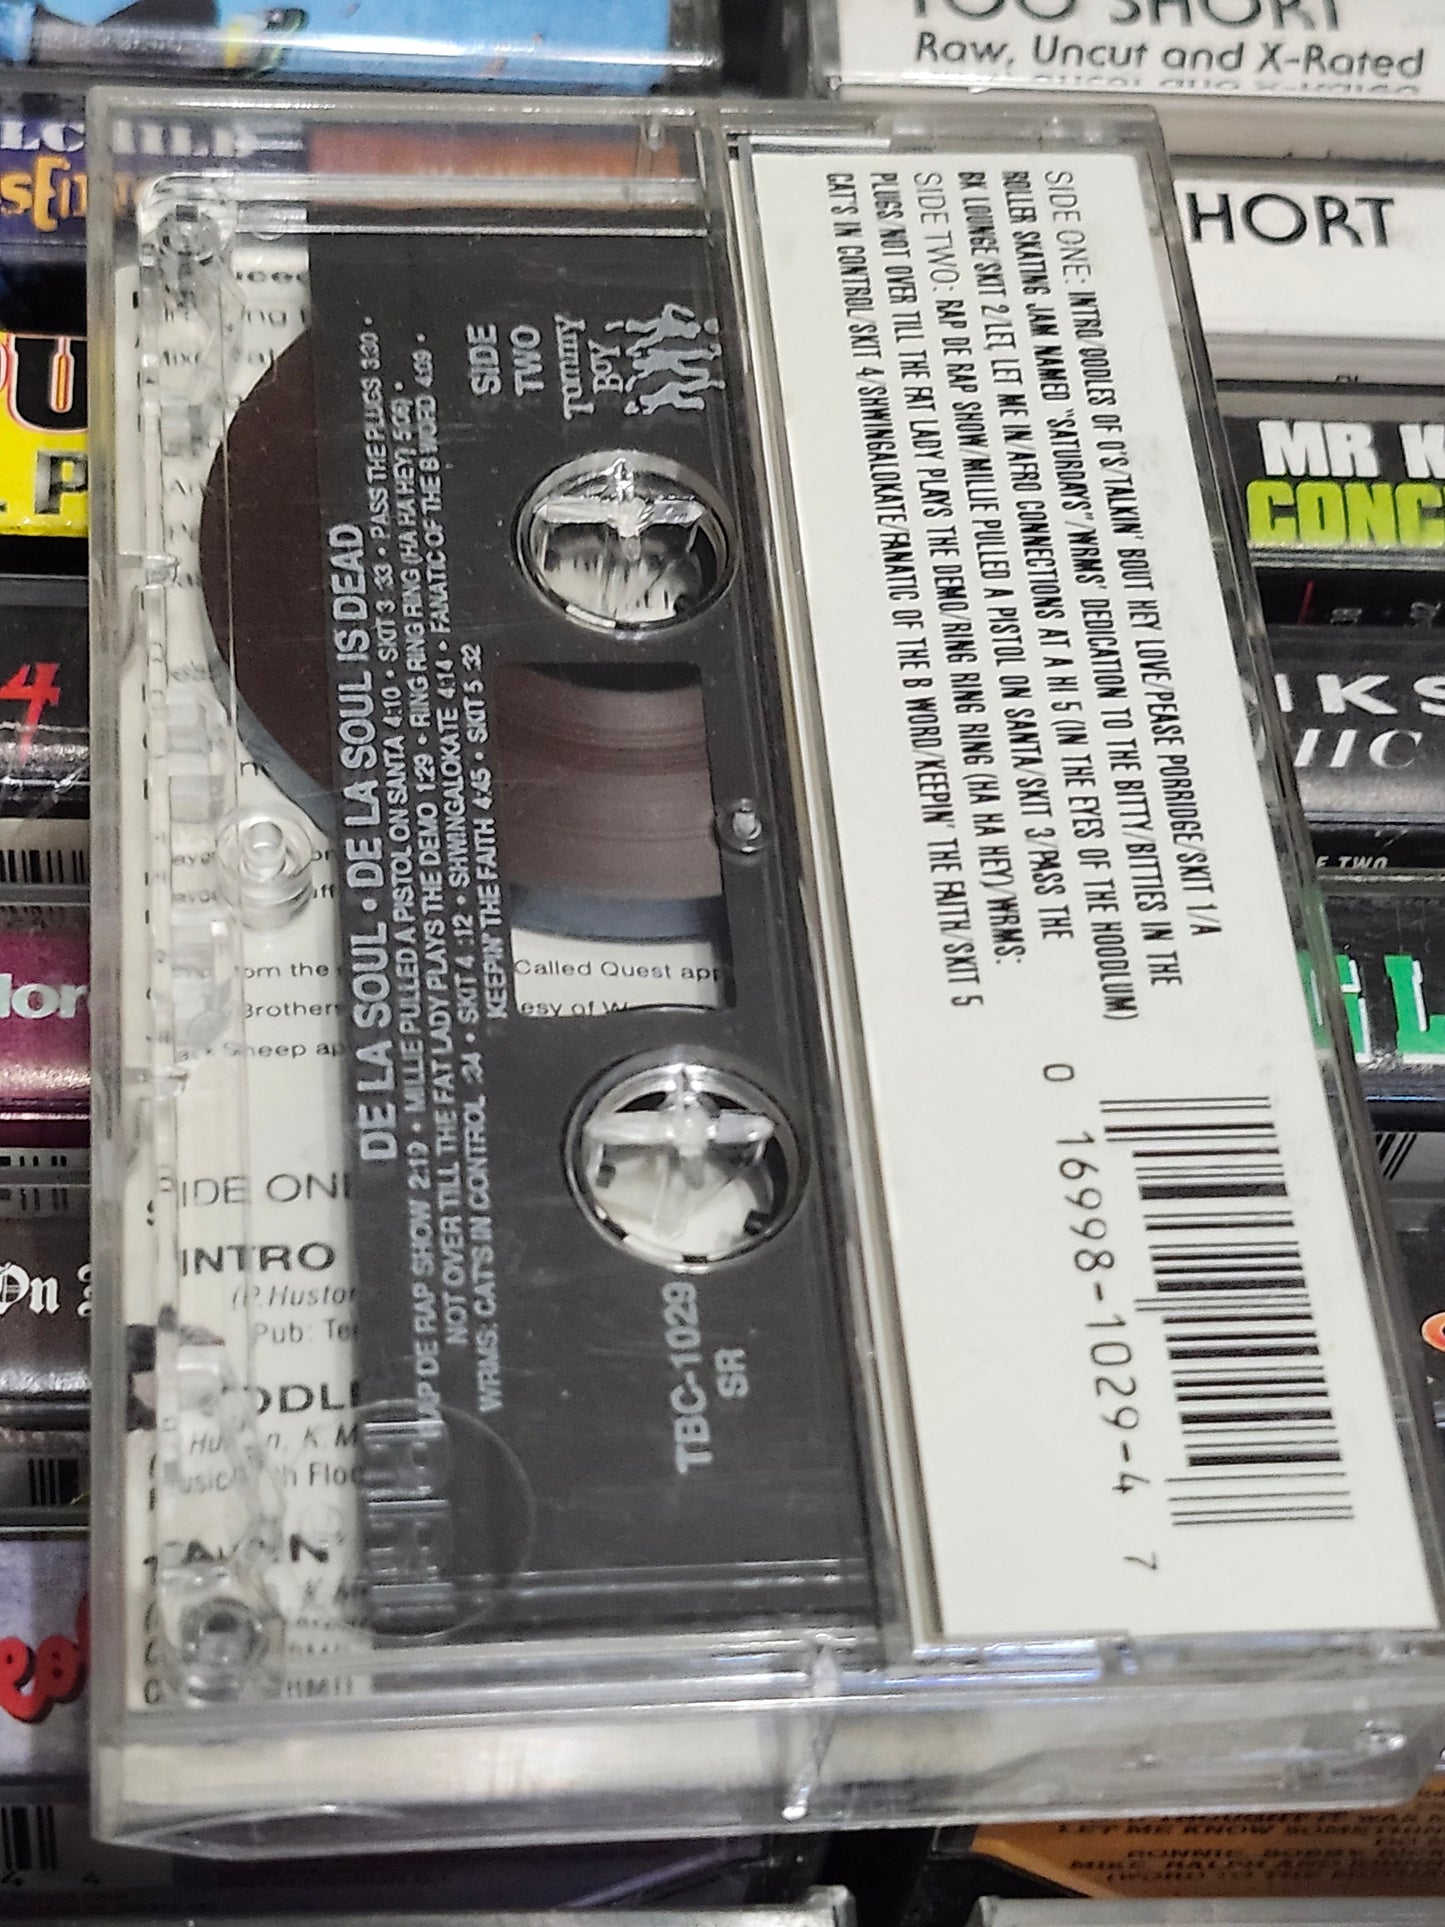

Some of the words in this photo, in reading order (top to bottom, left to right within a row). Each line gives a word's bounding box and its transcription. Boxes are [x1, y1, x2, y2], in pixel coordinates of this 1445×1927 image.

[914, 31, 1014, 67] Raw,
[1032, 34, 1148, 68] Uncut
[1160, 41, 1245, 73] and
[1254, 42, 1425, 78] X-Rated
[826, 172, 859, 215] CAT'S
[913, 172, 949, 224] SIDE
[1044, 170, 1081, 222] SIDE
[833, 221, 863, 238] IN
[925, 230, 960, 292] TWO:
[1011, 230, 1052, 295] SKATING
[1055, 229, 1092, 284] ONE:
[836, 245, 882, 359] CONTROL/SKIT
[884, 265, 918, 305] OVER
[891, 310, 925, 344] TILL
[935, 299, 968, 329] RAP
[1025, 302, 1060, 337] JAM
[467, 323, 502, 396] SIDE
[510, 325, 545, 397] TWO
[897, 349, 931, 379] THE
[941, 336, 973, 357] DE
[1067, 291, 1117, 406] INTRO/OODLES
[946, 362, 979, 393] RAP
[990, 358, 1024, 385] LET
[1033, 344, 1071, 401] NAMED
[903, 386, 937, 412] FAT
[996, 393, 1029, 418] ME
[908, 419, 945, 460] LADY
[1090, 414, 1123, 433] OF
[365, 438, 387, 483] THE
[951, 401, 1000, 512] SHOW/MILLIE
[1001, 424, 1043, 492] IN/AFRO
[1258, 419, 1381, 478] MR
[367, 486, 391, 539] PASS
[396, 498, 417, 526] HA
[419, 475, 442, 515] THE
[916, 468, 954, 518] PLAYS
[1095, 440, 1145, 540] O'S/TALKIN'
[422, 519, 445, 547] OF
[926, 525, 960, 557] THE
[971, 519, 1011, 580] PULLED
[328, 523, 368, 621] DEAD
[1015, 500, 1066, 620] CONNECTIONS
[1116, 548, 1155, 592] BOUT
[932, 564, 978, 664] DEMO/RING
[983, 587, 1015, 599] A
[1126, 599, 1162, 631] HEY
[891, 609, 925, 629] OF
[986, 606, 1027, 668] PISTOL
[1037, 628, 1071, 649] AT
[332, 628, 370, 662] IS
[403, 622, 428, 672] RING
[895, 636, 931, 671] THE
[1042, 656, 1074, 668] A
[1079, 598, 1129, 699] DEDICATION
[406, 675, 431, 728] RING
[901, 677, 934, 689] B
[949, 672, 987, 714] RING
[998, 675, 1033, 699] ON
[1046, 675, 1079, 693] HI
[1134, 639, 1185, 746] LOVE/PEASE
[338, 670, 378, 769] SOUL
[1050, 701, 1083, 712] 5
[1100, 707, 1134, 730] TO
[957, 722, 995, 766] RING
[1050, 719, 1089, 746] (IN
[1105, 737, 1142, 772] THE
[382, 735, 409, 805] SANTA
[1003, 708, 1053, 818] SANTA/SKIT
[1060, 753, 1097, 788] THE
[342, 779, 381, 826] LA
[962, 773, 1001, 805] (HA
[388, 808, 411, 842] ON
[416, 802, 441, 866] DEMO
[972, 812, 1007, 837] HA
[1067, 795, 1106, 839] EYES
[1156, 754, 1215, 894] PORRIDGE/SKIT
[344, 837, 384, 889] DE
[472, 817, 498, 880] FAITH
[927, 837, 963, 873] THE
[1024, 827, 1067, 896] 3/PASS
[1077, 848, 1112, 870] OF
[1113, 779, 1169, 912] BITTY/BITTIES
[390, 844, 416, 923] PISTOL
[419, 870, 444, 916] THE
[476, 884, 503, 929] THE
[1082, 878, 1120, 913] THE
[932, 880, 981, 985] FAITH/SKIT
[1037, 904, 1074, 940] THE
[1140, 921, 1174, 941] IN
[1186, 903, 1223, 936] 1/A
[349, 921, 392, 1029] SOUL
[422, 918, 449, 991] PLAYS
[514, 959, 592, 977] Called
[600, 961, 671, 980] Quest
[1090, 921, 1139, 1021] HOODLUM)
[1145, 950, 1183, 986] THE
[394, 947, 422, 1034] PULLED
[453, 972, 480, 1024] SKIT
[950, 994, 984, 1007] 5
[427, 995, 454, 1055] LADY
[355, 1039, 395, 1092] LA
[399, 1039, 426, 1113] MILLIE
[430, 1059, 455, 1105] FAT
[1042, 1062, 1076, 1083] 0
[355, 1101, 398, 1161] DE
[433, 1110, 458, 1156] THE
[462, 1094, 491, 1211] CONTROL
[436, 1161, 462, 1212] TILL
[407, 1197, 435, 1277] SHOW
[438, 1215, 466, 1288] OVER
[468, 1216, 493, 1242] IN
[181, 1241, 336, 1277] INTRO
[411, 1282, 437, 1334] RAP
[441, 1291, 469, 1346] NOT
[413, 1339, 440, 1377] DE
[662, 1281, 714, 1475] TBC-1029
[714, 1348, 750, 1398] SR
